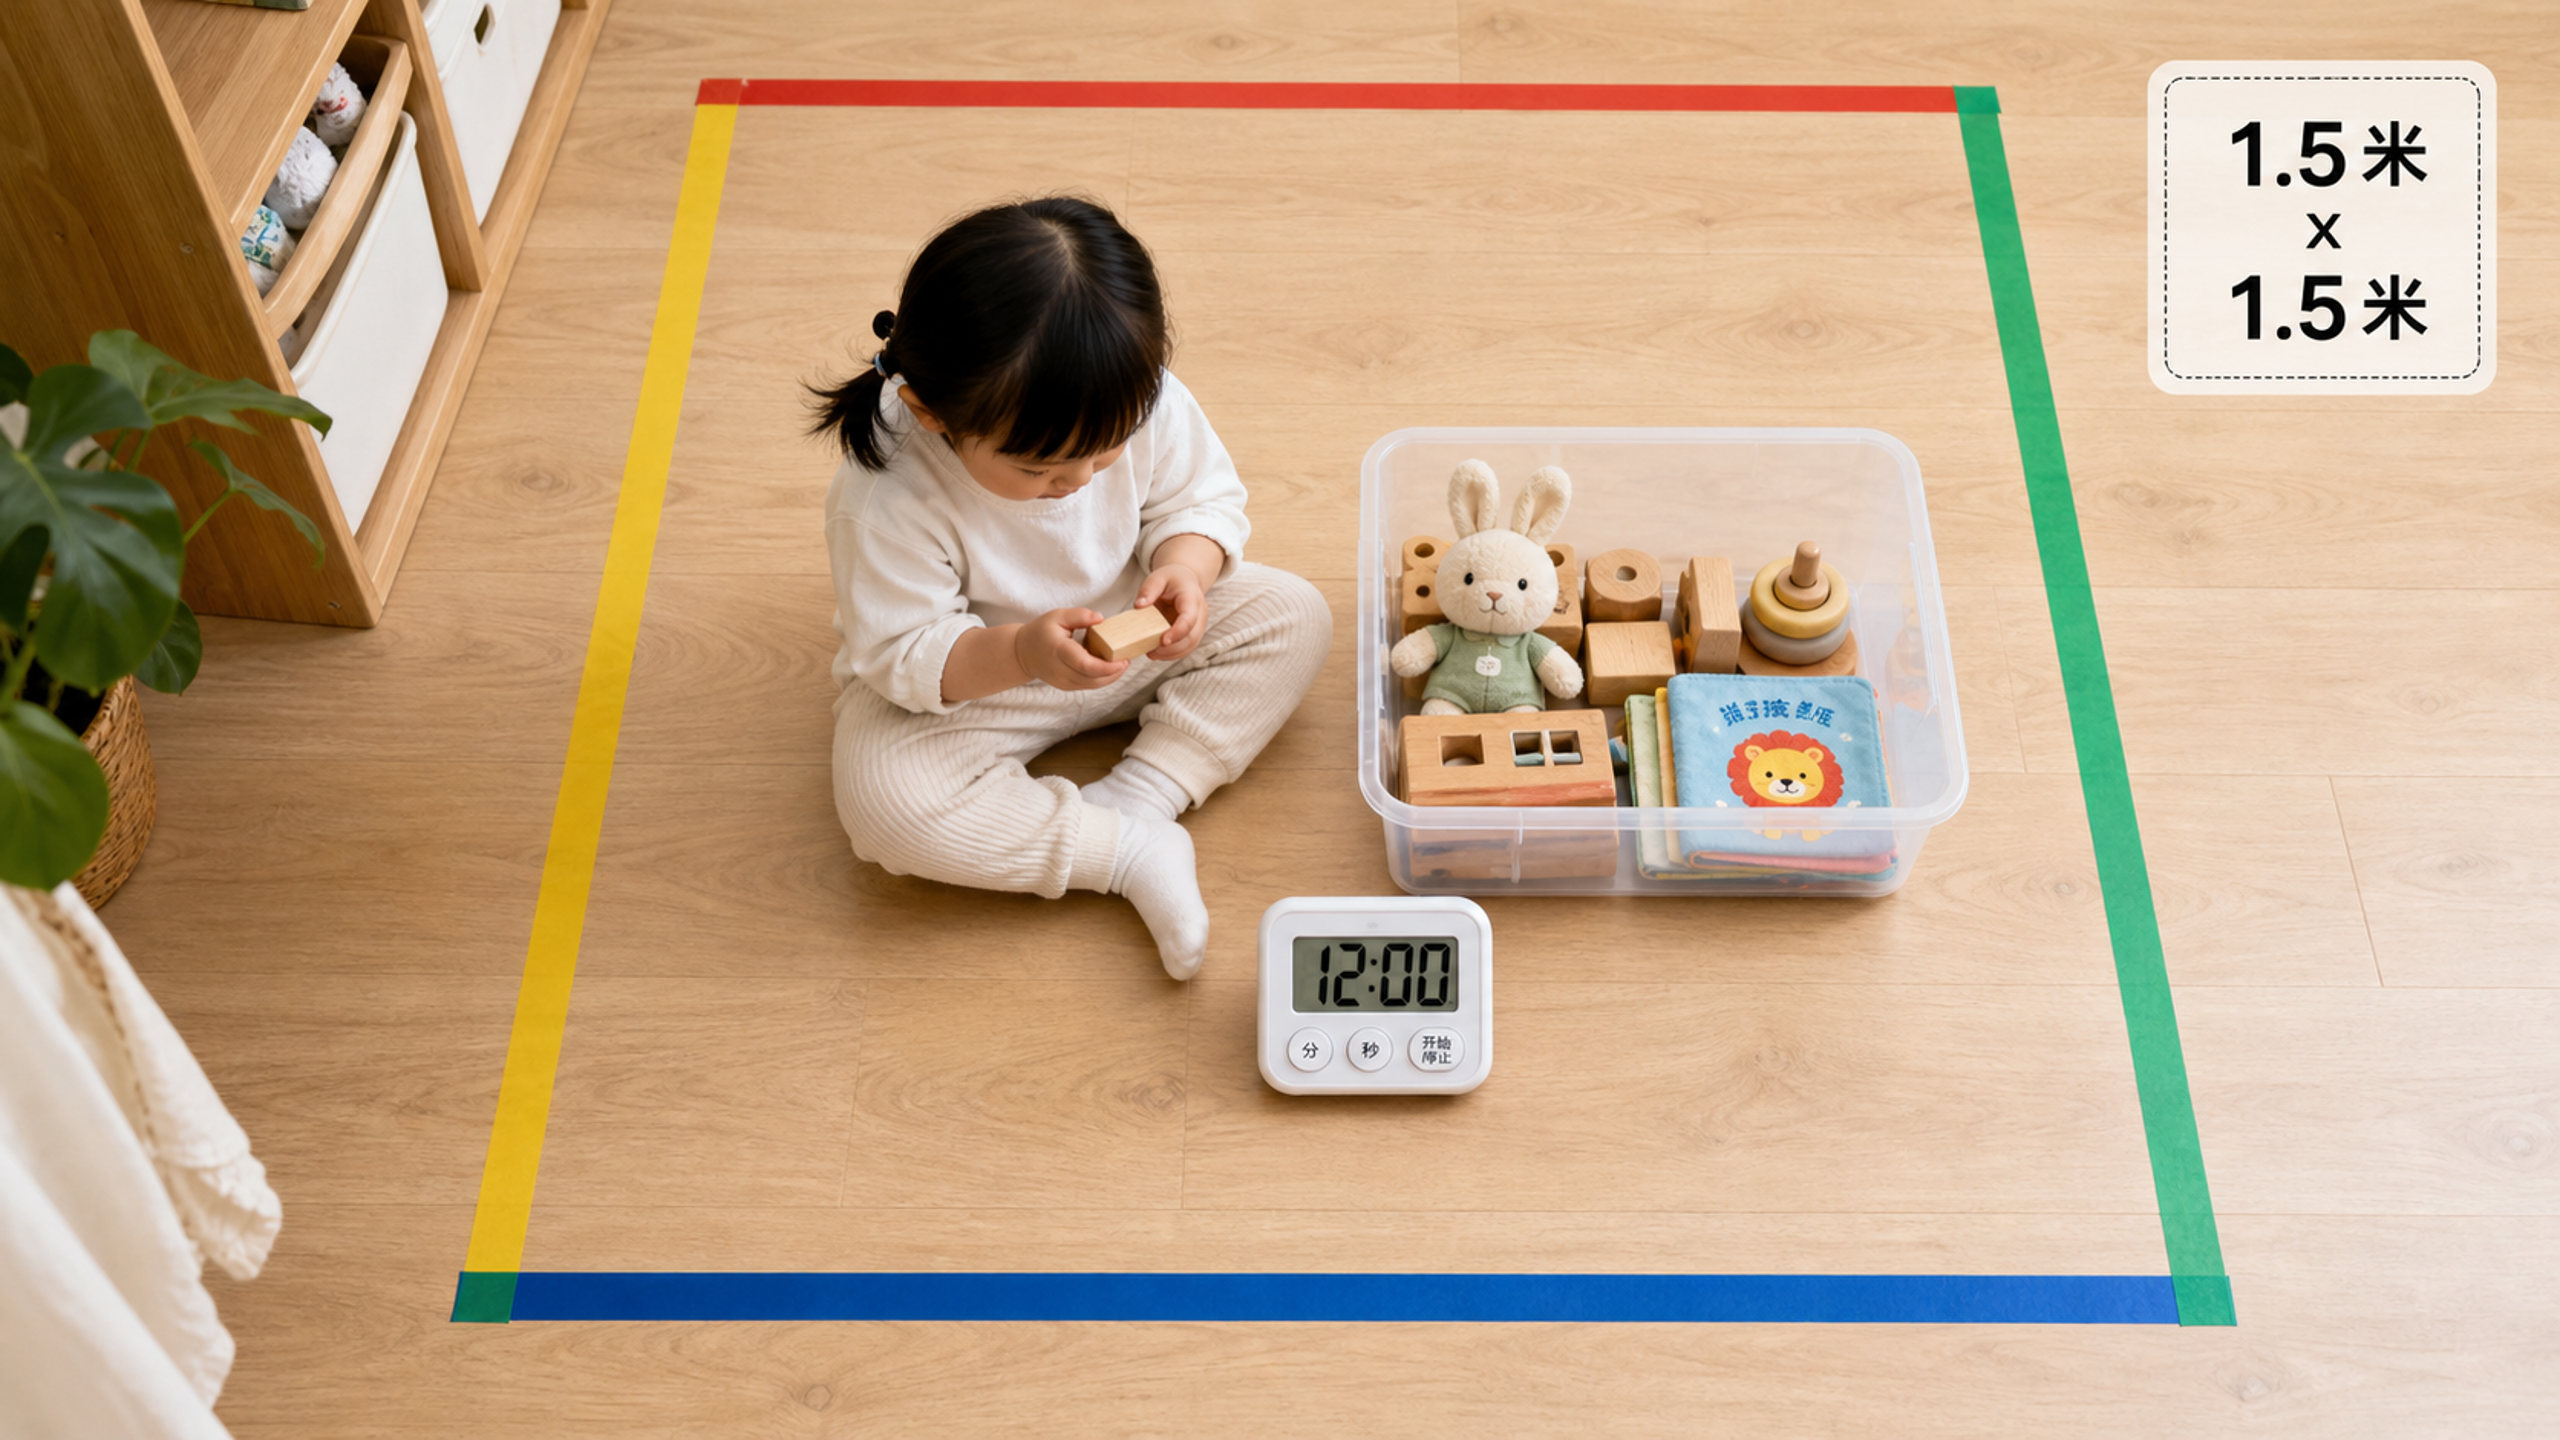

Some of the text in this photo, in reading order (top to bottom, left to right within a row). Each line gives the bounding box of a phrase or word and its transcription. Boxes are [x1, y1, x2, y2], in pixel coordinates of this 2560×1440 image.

[1318, 942, 1451, 1007] 12:00
[1302, 1042, 1319, 1059] 分
[1361, 1041, 1380, 1059] 秒
